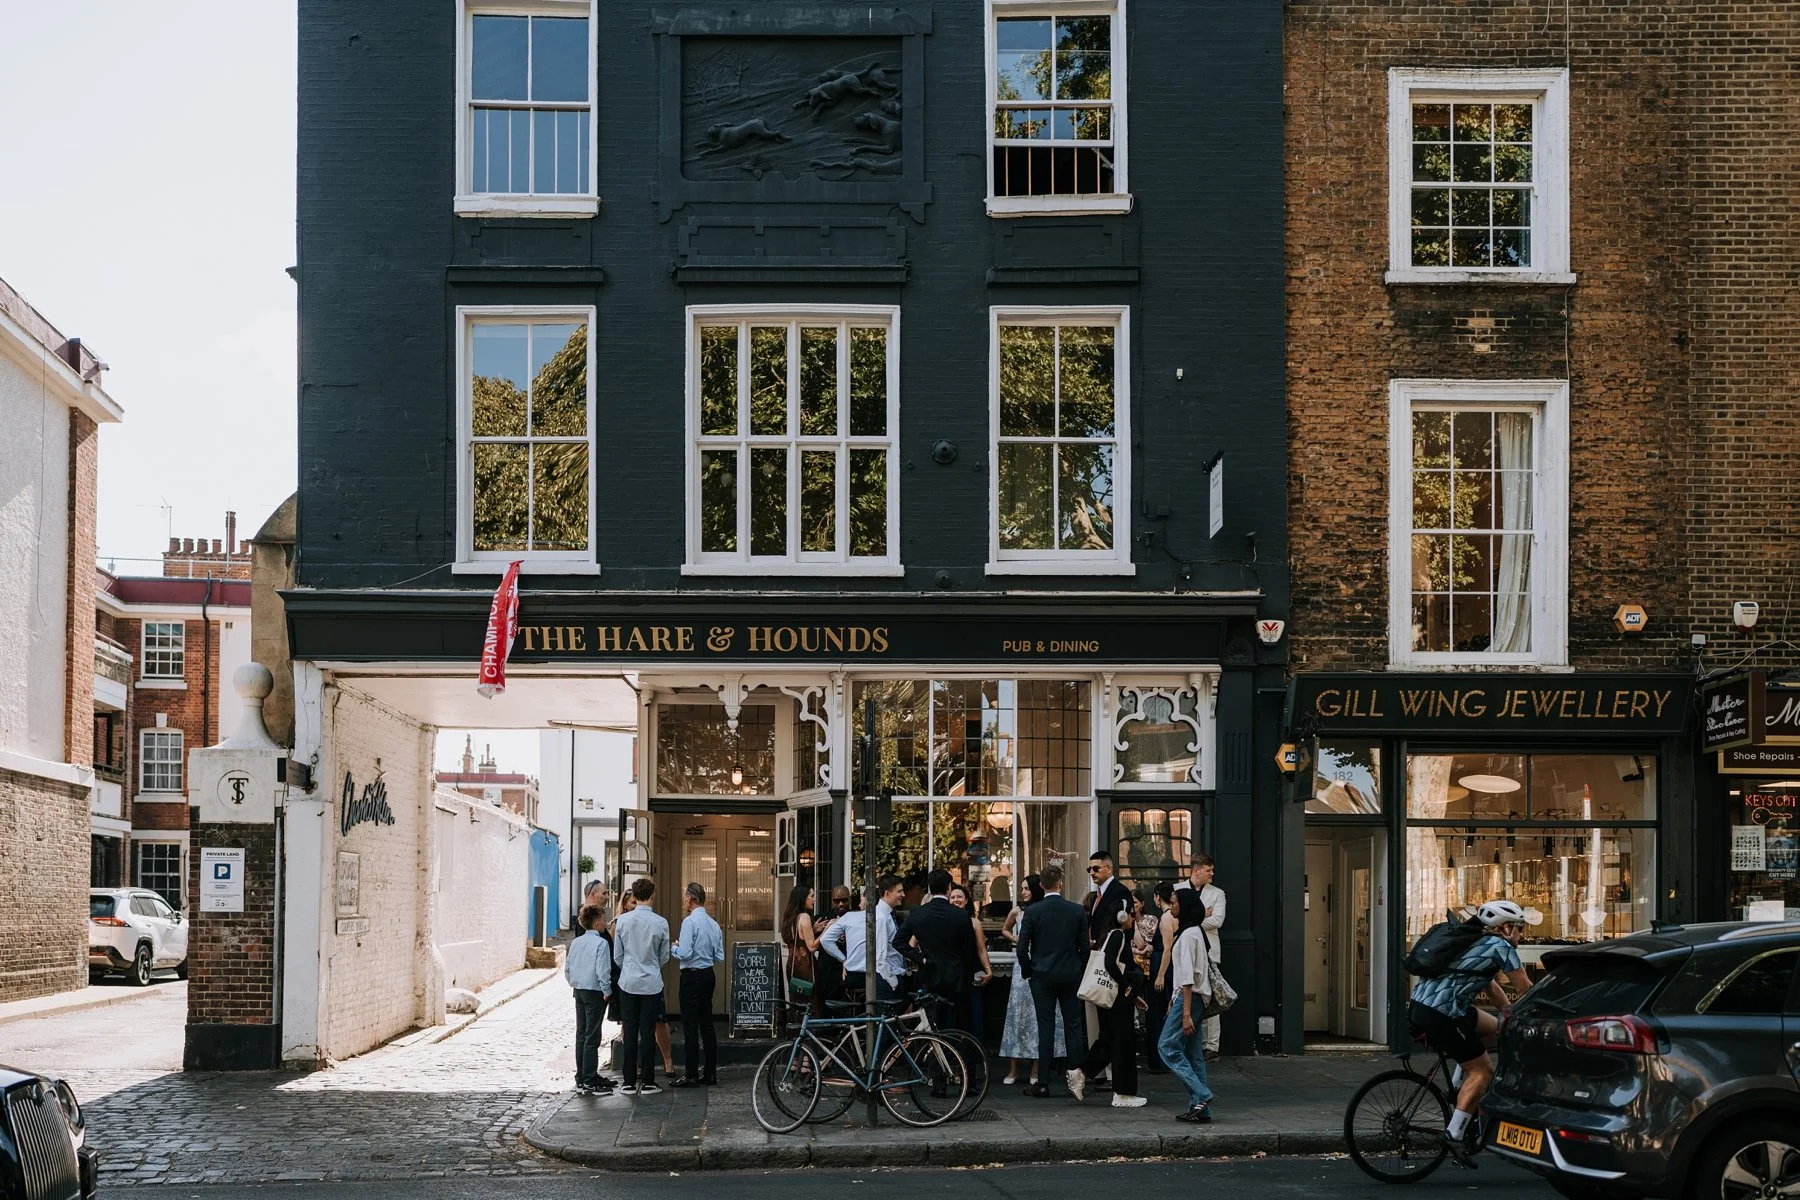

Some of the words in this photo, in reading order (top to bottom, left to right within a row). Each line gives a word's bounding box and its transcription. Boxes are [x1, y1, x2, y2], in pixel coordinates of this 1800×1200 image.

[1626, 614, 1640, 622] ADT
[517, 626, 587, 651] THE
[597, 626, 695, 652] HARE
[706, 626, 735, 652] &
[747, 626, 889, 653] HOUNDS
[1002, 640, 1032, 652] PUB
[1036, 640, 1045, 652] &
[1050, 640, 1100, 653] DINING
[1315, 689, 1384, 717] GILL
[1398, 689, 1487, 718] WING
[1496, 689, 1673, 718] JEWELLERY
[1733, 751, 1757, 760] Shoe
[1759, 752, 1794, 761] Repairs
[1333, 771, 1353, 781] 182
[1745, 794, 1773, 807] KEYS
[1776, 795, 1797, 807] CUT
[755, 968, 766, 976] ARE
[1093, 968, 1108, 978] ace
[739, 975, 769, 986] CLOSED
[1097, 977, 1114, 990] tate
[741, 1001, 766, 1013] EVENT
[1519, 1130, 1538, 1150] OTU
